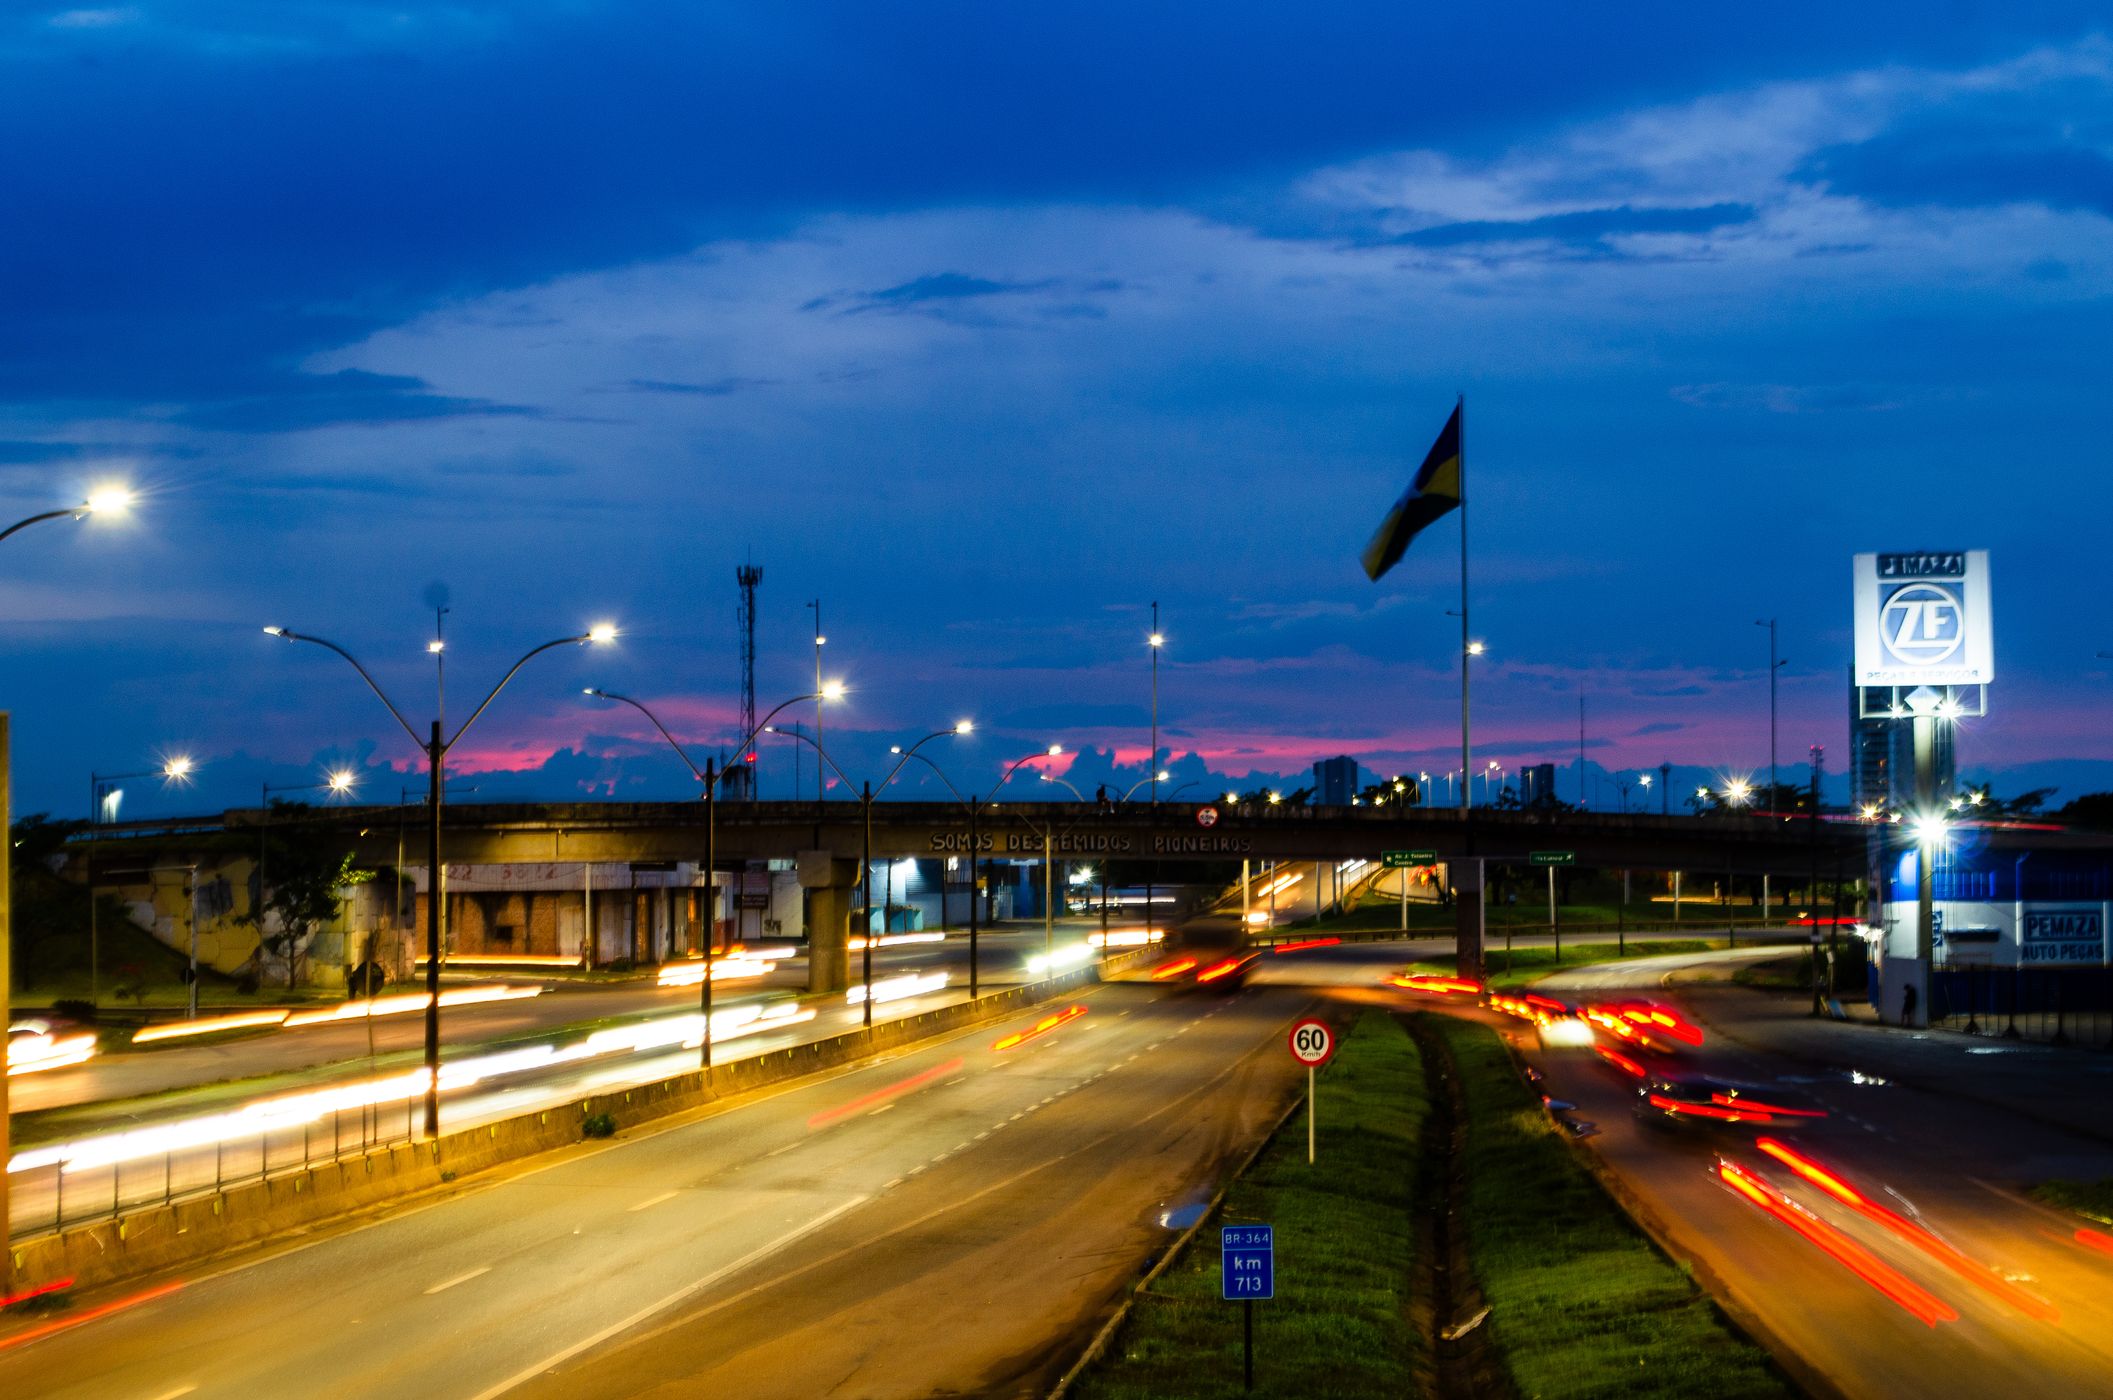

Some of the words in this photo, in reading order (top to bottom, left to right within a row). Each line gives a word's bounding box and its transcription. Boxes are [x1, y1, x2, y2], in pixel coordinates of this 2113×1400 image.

[1889, 600, 1955, 648] ZF
[931, 833, 994, 851] SOMOS
[1008, 833, 1131, 851] DESTEMIDOS
[1154, 835, 1251, 852] PIONEIROS
[2026, 916, 2097, 937] PEMAZA
[2022, 944, 2056, 960] AUTO
[2060, 944, 2104, 961] PEÇAS
[1296, 1029, 1325, 1051] 60
[1225, 1233, 1269, 1244] BR-364
[1234, 1256, 1262, 1270] km
[1234, 1277, 1262, 1292] 713
